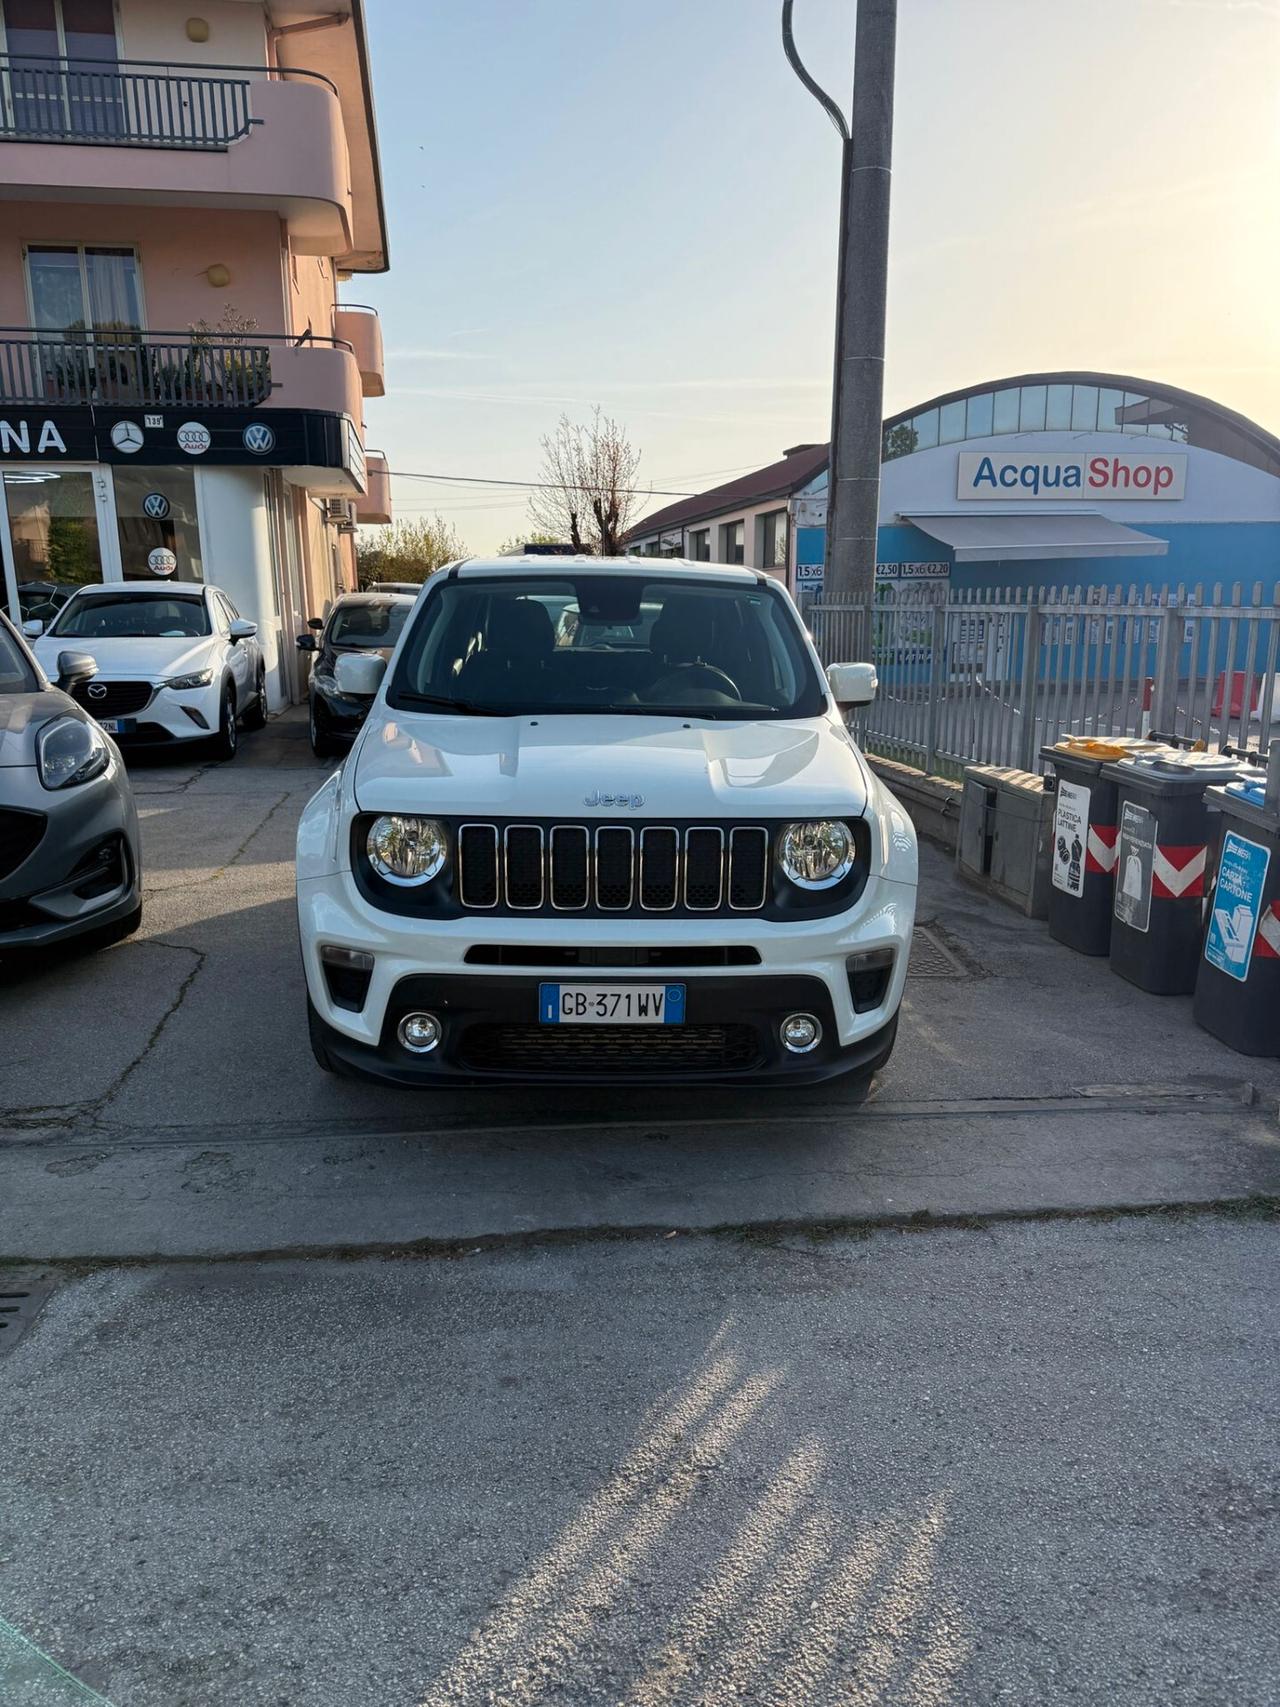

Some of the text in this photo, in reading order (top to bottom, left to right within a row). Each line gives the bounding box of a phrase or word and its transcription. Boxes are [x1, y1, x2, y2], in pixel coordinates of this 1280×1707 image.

[0, 420, 67, 453] NA
[973, 456, 1174, 496] Acqua Shop
[811, 566, 822, 576] x6
[583, 789, 645, 810] Jeep
[1057, 808, 1082, 825] PLASTICA
[1220, 878, 1253, 903] CARTONE
